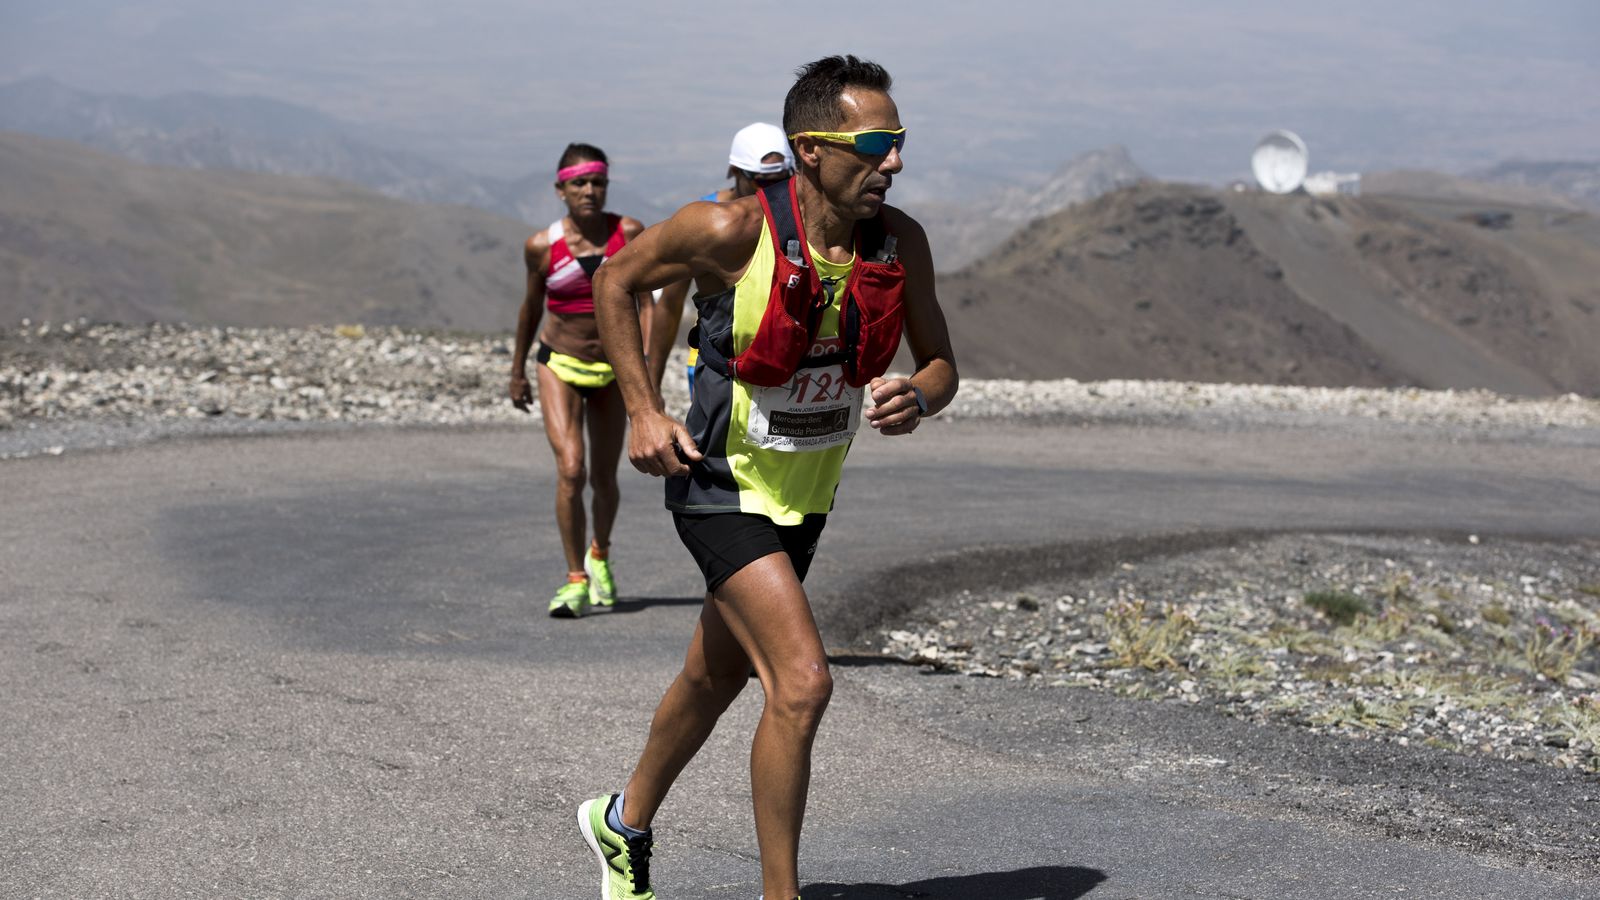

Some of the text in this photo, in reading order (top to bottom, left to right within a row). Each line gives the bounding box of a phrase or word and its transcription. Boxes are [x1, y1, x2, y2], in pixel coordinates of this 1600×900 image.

[794, 372, 847, 404] 121
[771, 424, 804, 436] Granada
[805, 424, 833, 435] Premium
